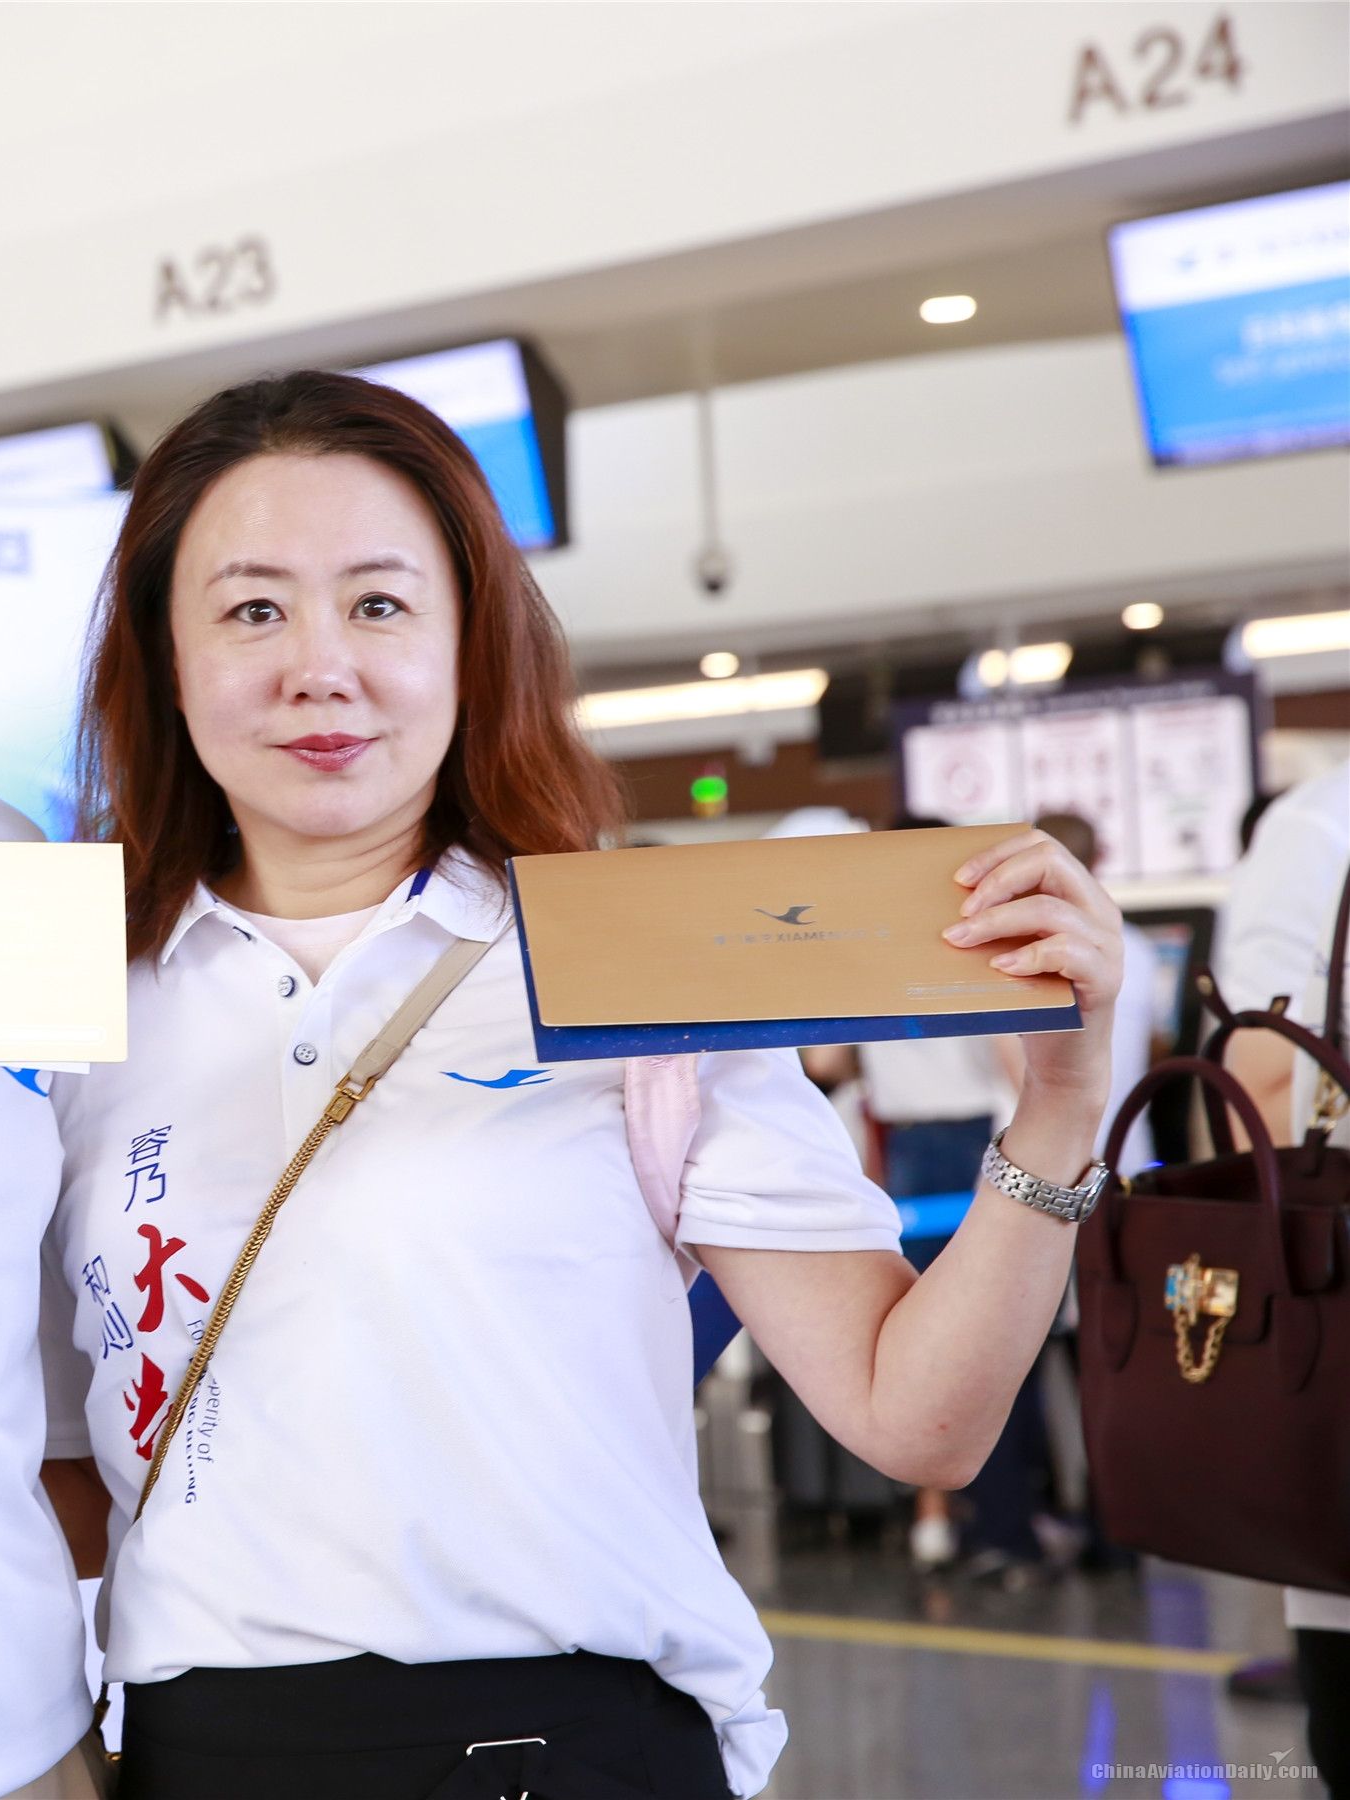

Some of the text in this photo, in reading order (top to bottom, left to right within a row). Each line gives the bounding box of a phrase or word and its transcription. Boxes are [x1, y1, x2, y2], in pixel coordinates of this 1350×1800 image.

[1068, 12, 1244, 126] A24
[153, 234, 277, 324] A23
[197, 1443, 214, 1464] of
